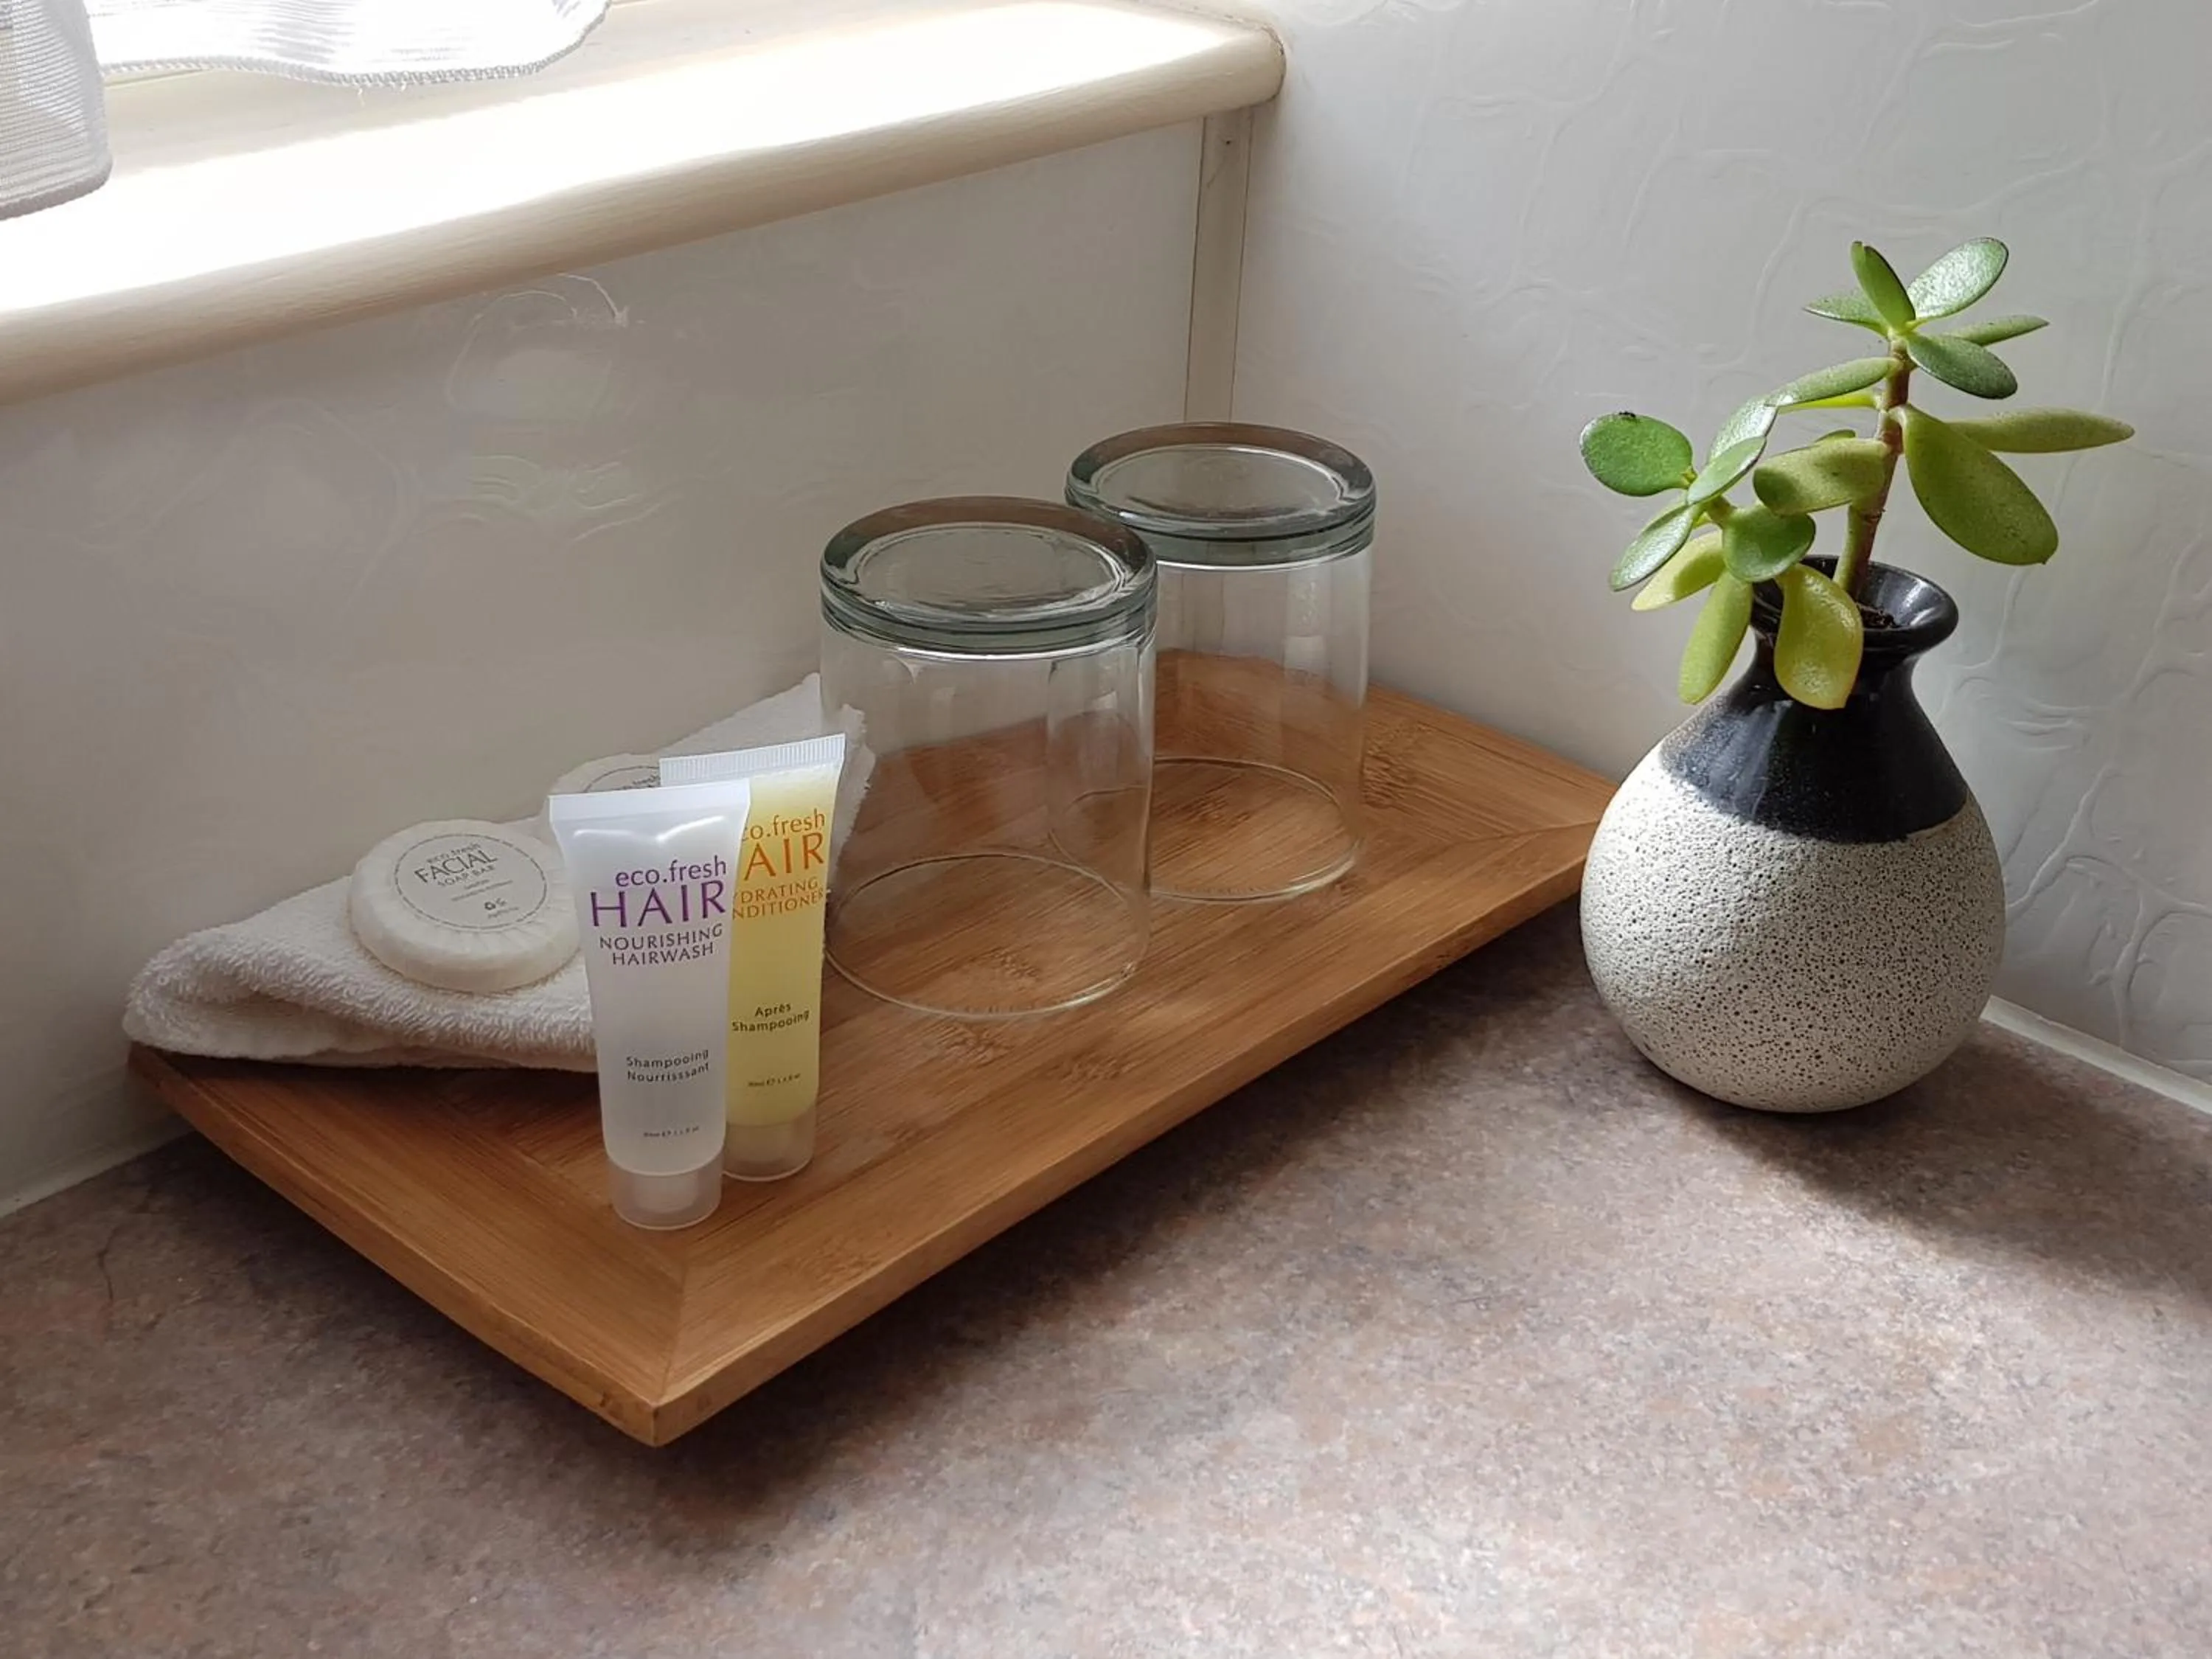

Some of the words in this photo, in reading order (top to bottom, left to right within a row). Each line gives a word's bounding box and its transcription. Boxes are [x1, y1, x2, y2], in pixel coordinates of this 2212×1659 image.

[742, 808, 825, 841] o.fresh
[414, 849, 498, 883] FACIAL
[615, 855, 727, 887] eco.fresh
[743, 832, 824, 881] AIR
[590, 880, 726, 928] HAIR
[731, 887, 824, 920] NDITIONER
[734, 876, 818, 904] DRATING
[599, 922, 723, 950] NOURISHING
[612, 942, 714, 966] HAIRWASH
[731, 1009, 810, 1032] Shampooing
[626, 1049, 709, 1068] Shampooing
